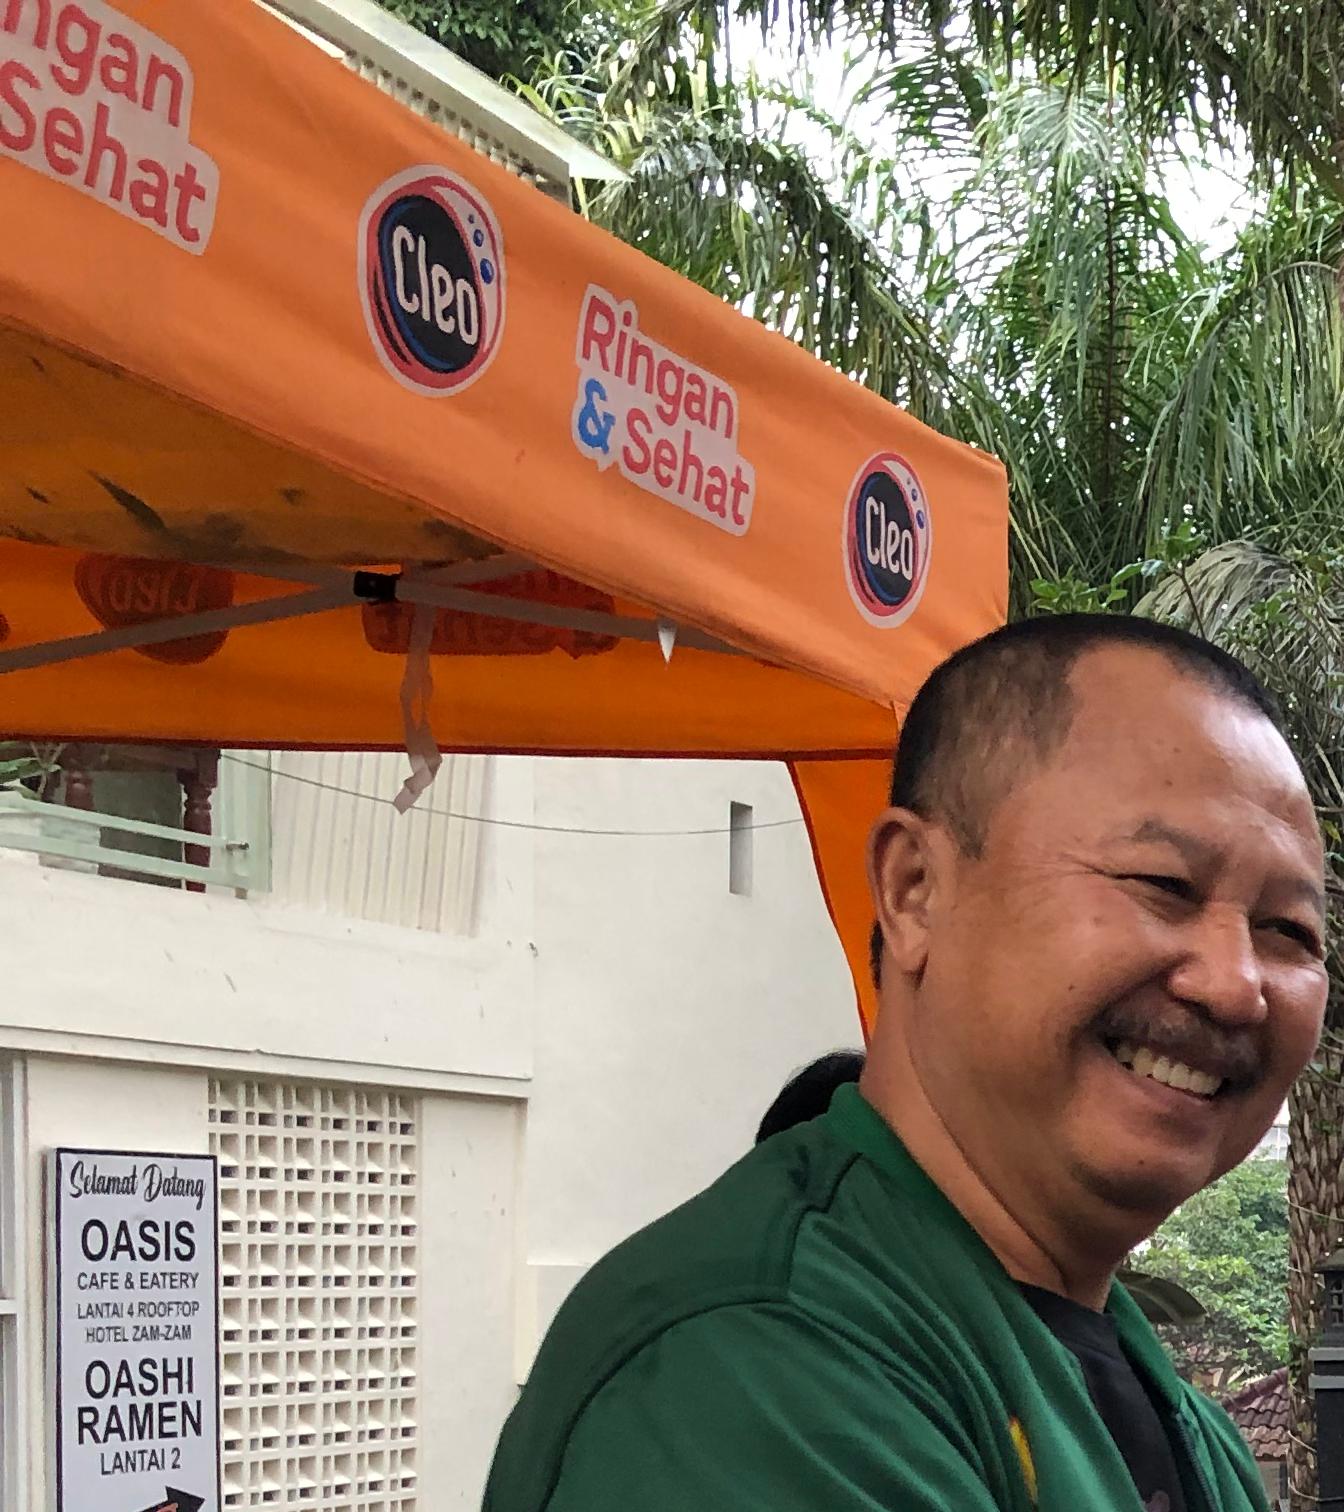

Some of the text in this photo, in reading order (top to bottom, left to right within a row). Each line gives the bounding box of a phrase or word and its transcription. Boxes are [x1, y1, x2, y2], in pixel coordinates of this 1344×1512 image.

[0, 60, 206, 243] Sehat
[392, 225, 479, 346] Cleo
[581, 295, 735, 439] Ringan
[578, 378, 750, 526] & Sehat
[865, 496, 914, 581] Cleo
[69, 1160, 206, 1211] Selamat Datang
[81, 1218, 196, 1262] OASIS
[77, 1272, 200, 1291] CAFE & EATERY
[77, 1301, 200, 1320] LANTAI 4 ROOFTOP
[86, 1325, 192, 1343] HOTEL ZAM-ZAM
[85, 1357, 194, 1399] OASHI
[77, 1400, 202, 1445] RAMEN
[101, 1447, 181, 1475] LANTAI 2
